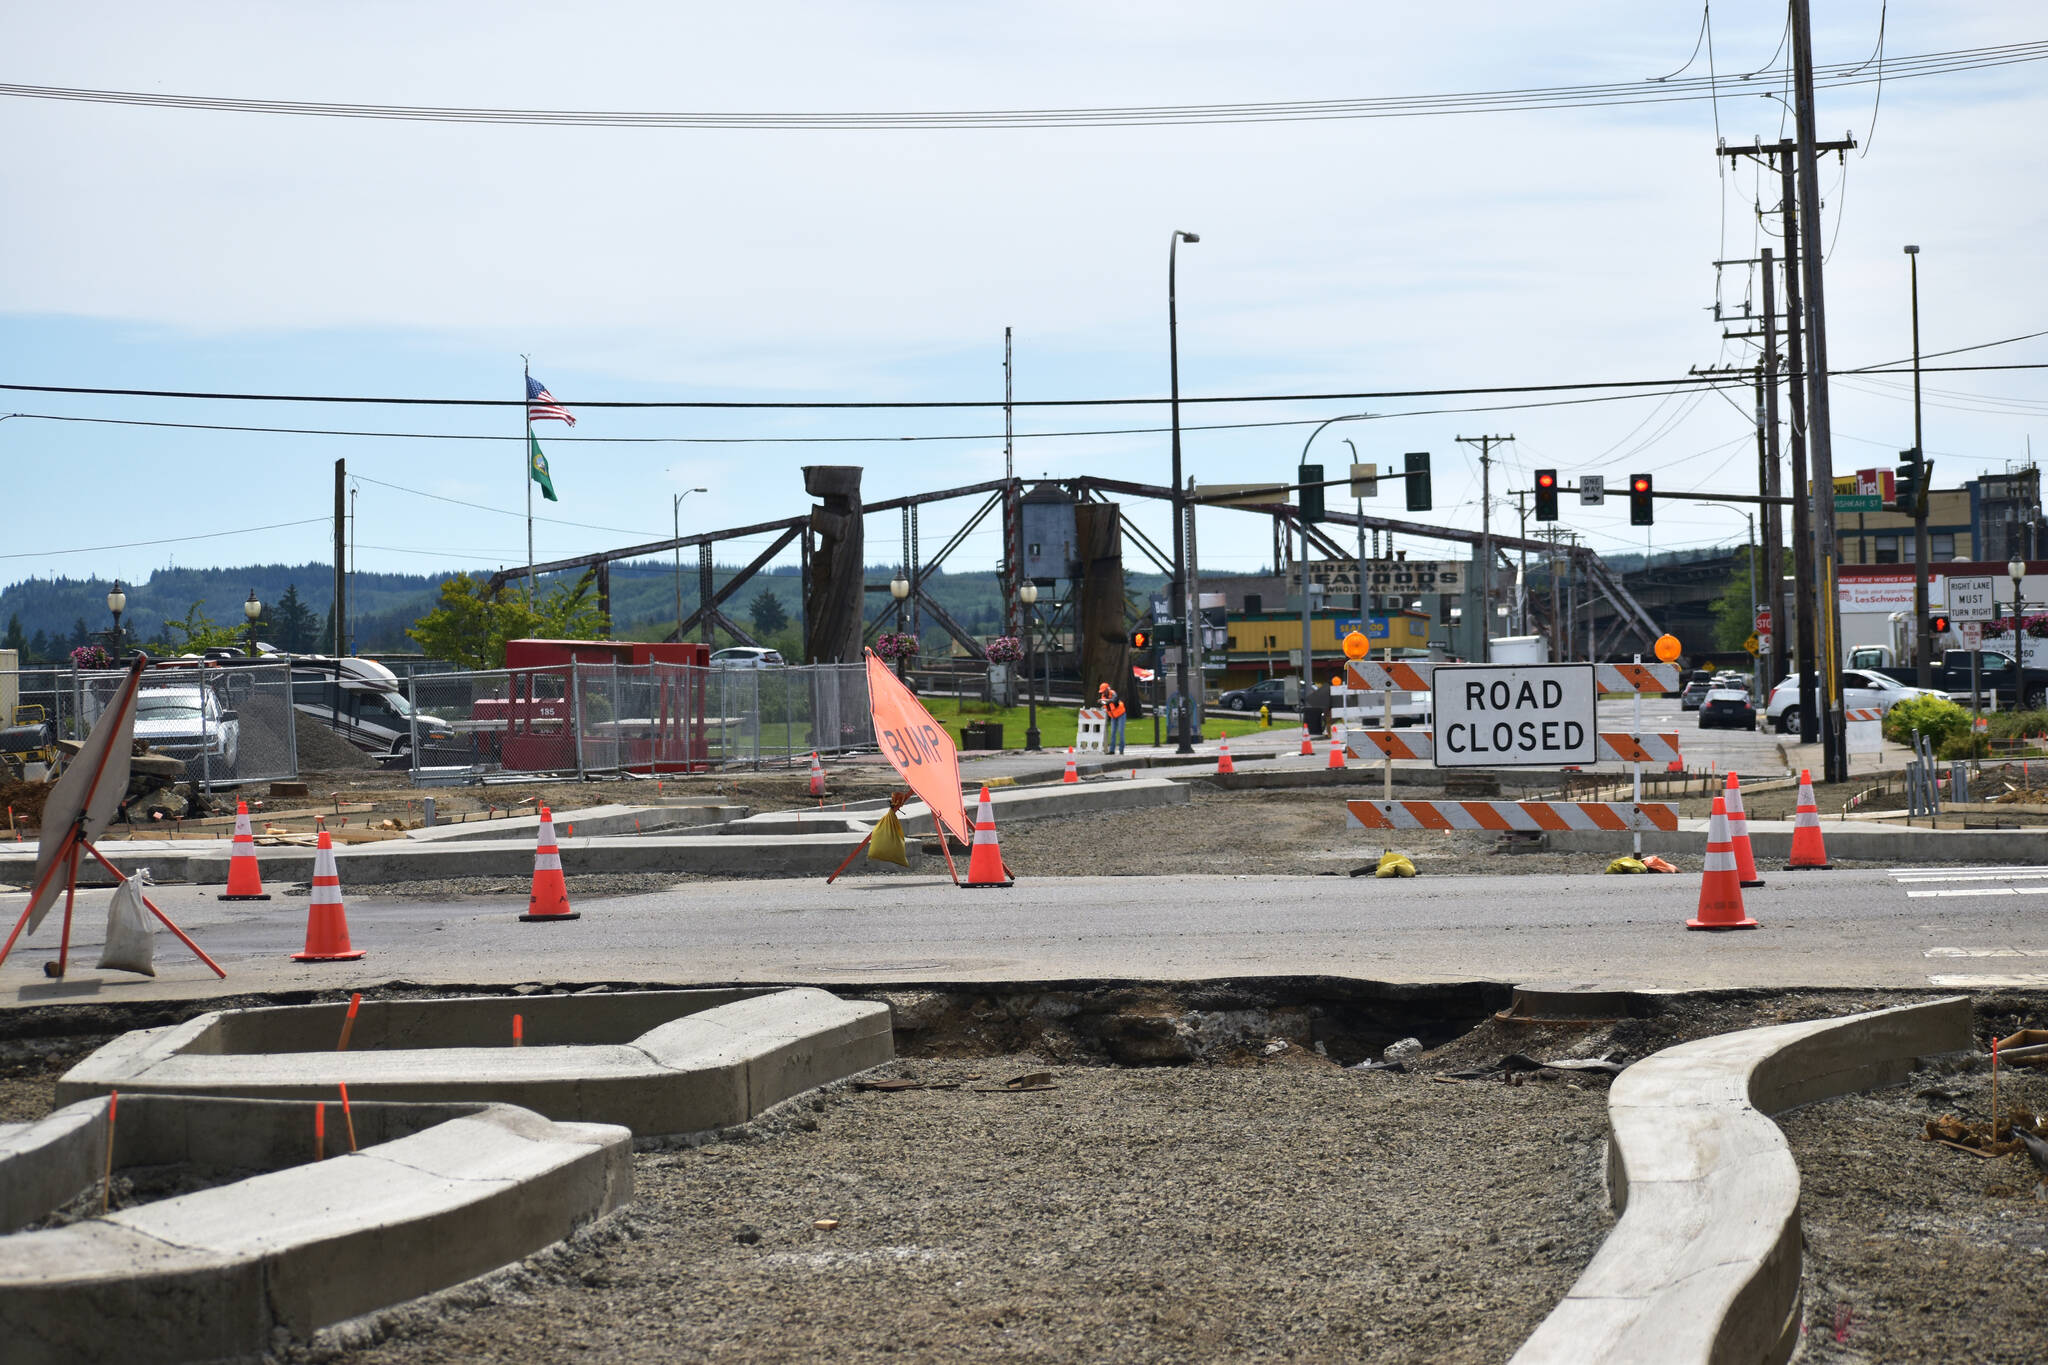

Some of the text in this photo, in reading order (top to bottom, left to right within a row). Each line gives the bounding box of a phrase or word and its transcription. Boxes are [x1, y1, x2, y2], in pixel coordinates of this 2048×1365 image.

[1309, 563, 1438, 573] BREAWATER
[1325, 585, 1386, 593] WHOLEALE
[1973, 582, 1990, 590] LANE
[1855, 595, 1913, 603] LesSchwab.c
[1959, 595, 1983, 604] MUST
[1952, 608, 1991, 617] TURN RIGHT
[1756, 619, 1771, 627] STO
[1466, 680, 1562, 710] ROAD
[1446, 721, 1584, 753] CLOSED
[883, 725, 942, 768] BUMP
